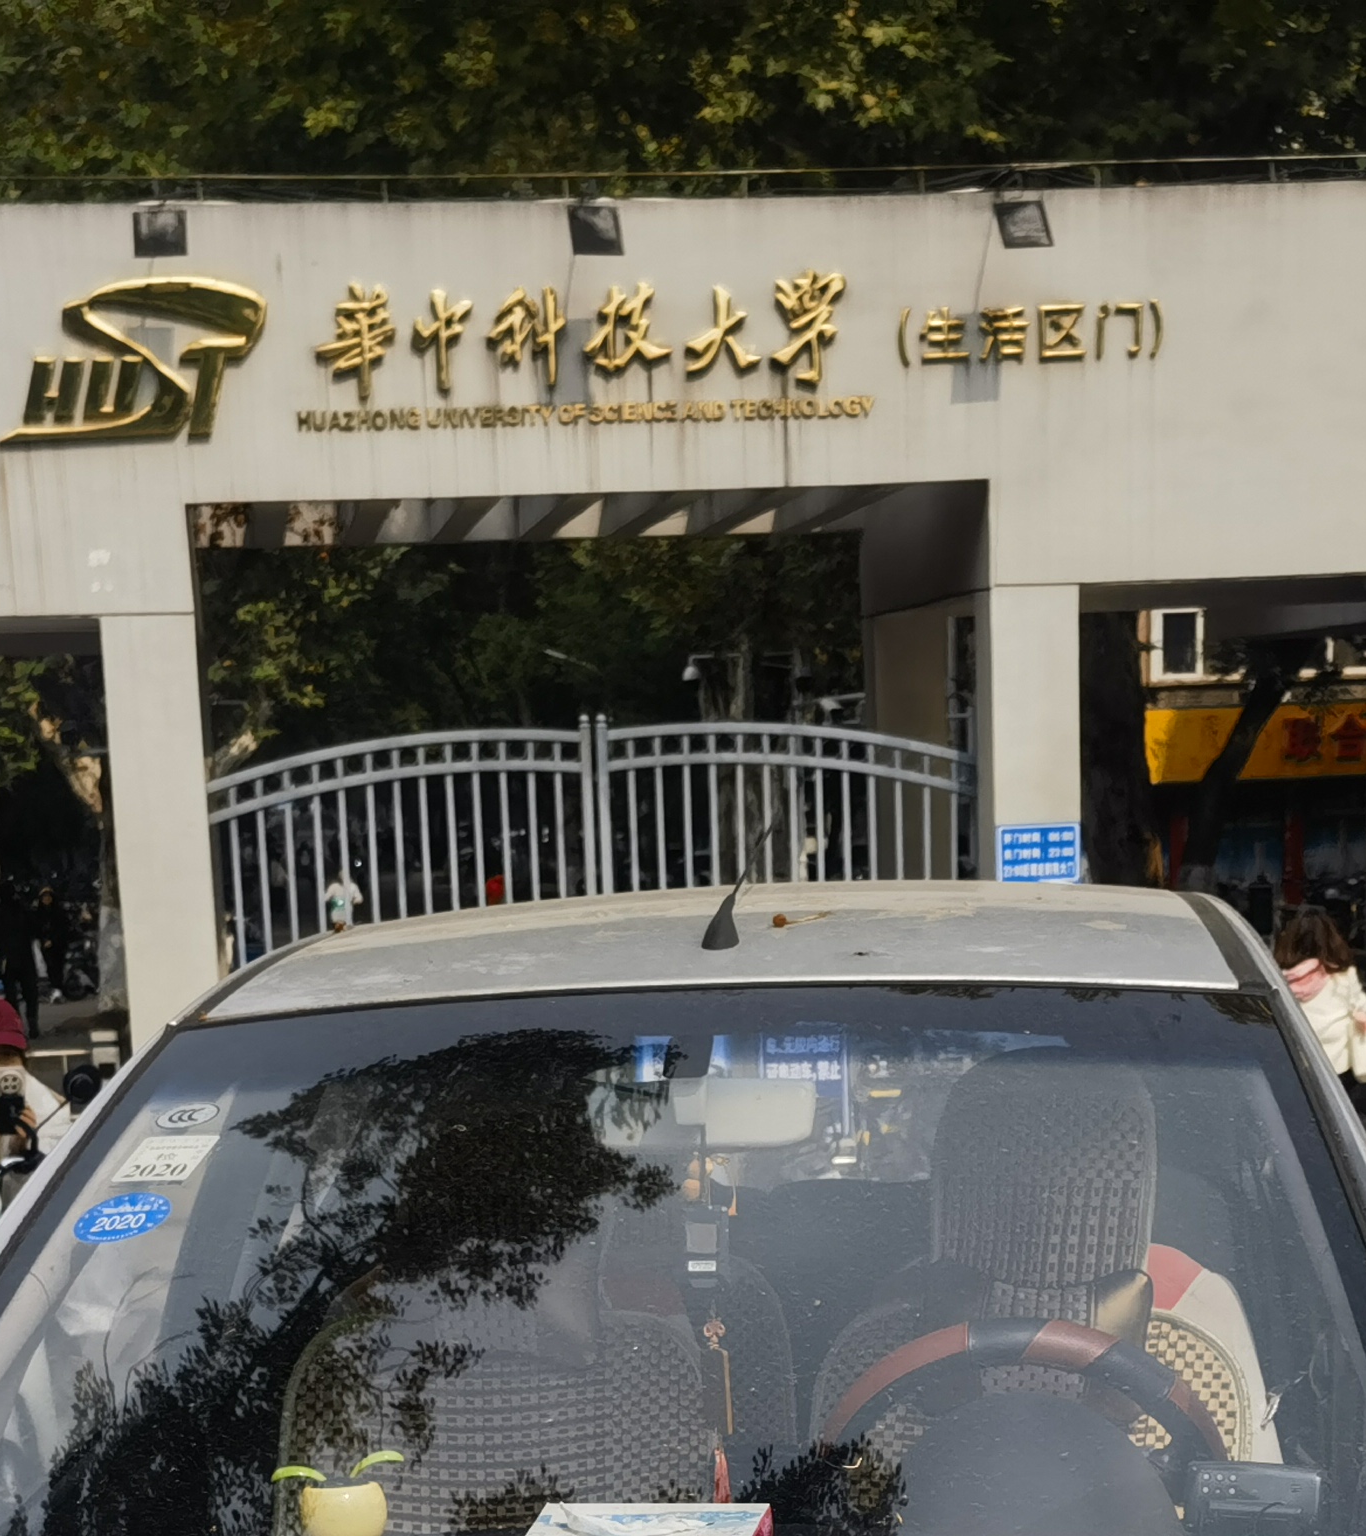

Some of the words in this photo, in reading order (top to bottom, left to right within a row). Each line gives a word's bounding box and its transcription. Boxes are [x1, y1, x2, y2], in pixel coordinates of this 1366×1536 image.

[897, 299, 1164, 368] (生活区门)
[297, 407, 422, 432] HUAZHONG
[426, 404, 553, 430] UNIVERSITY
[557, 402, 587, 423] OF
[589, 400, 679, 423] SCIENCE
[684, 399, 726, 422] AND
[731, 395, 874, 421] TECHNOLOGY
[121, 1163, 188, 1179] 2020
[90, 1213, 147, 1233] 2020
